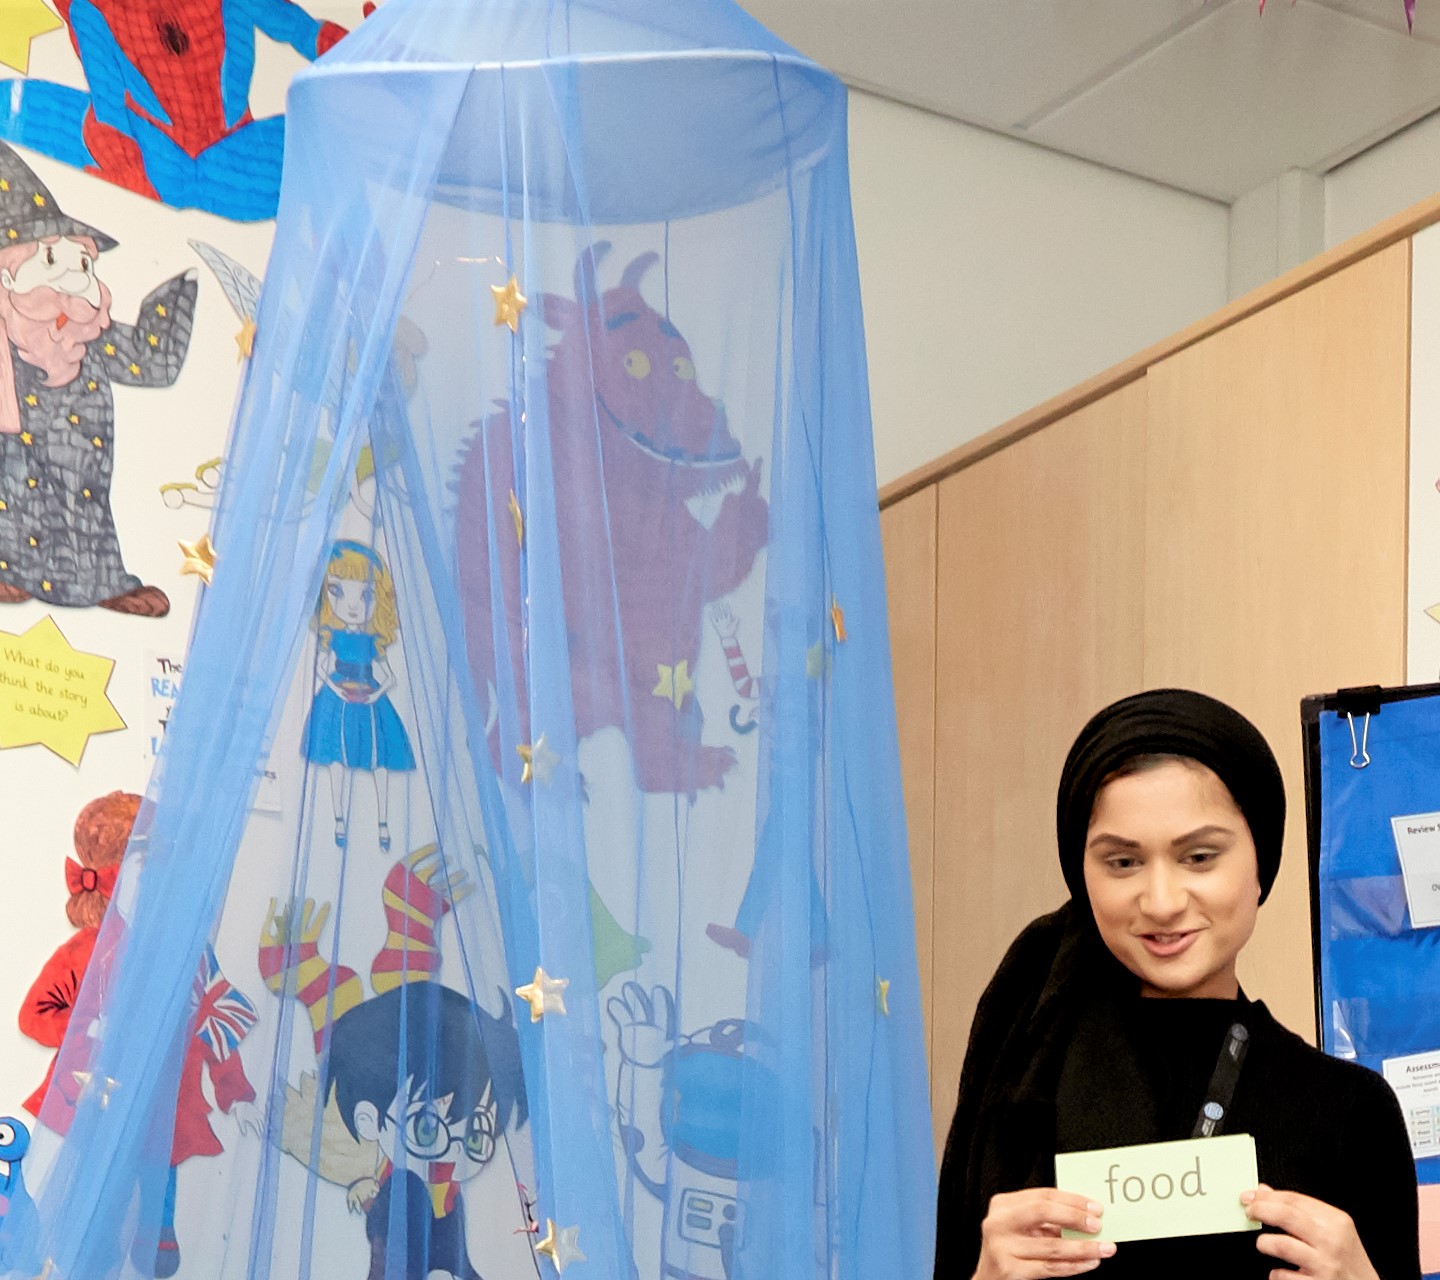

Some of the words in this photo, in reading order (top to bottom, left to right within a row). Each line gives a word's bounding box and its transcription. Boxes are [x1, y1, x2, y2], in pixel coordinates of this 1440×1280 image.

[4, 648, 40, 669] What
[45, 661, 60, 673] do
[64, 666, 85, 681] you
[0, 671, 29, 690] think
[35, 681, 54, 697] the
[59, 687, 88, 708] story
[15, 701, 25, 713] is
[29, 704, 69, 721] about?
[1407, 825, 1436, 835] Review
[1104, 1156, 1207, 1204] food
